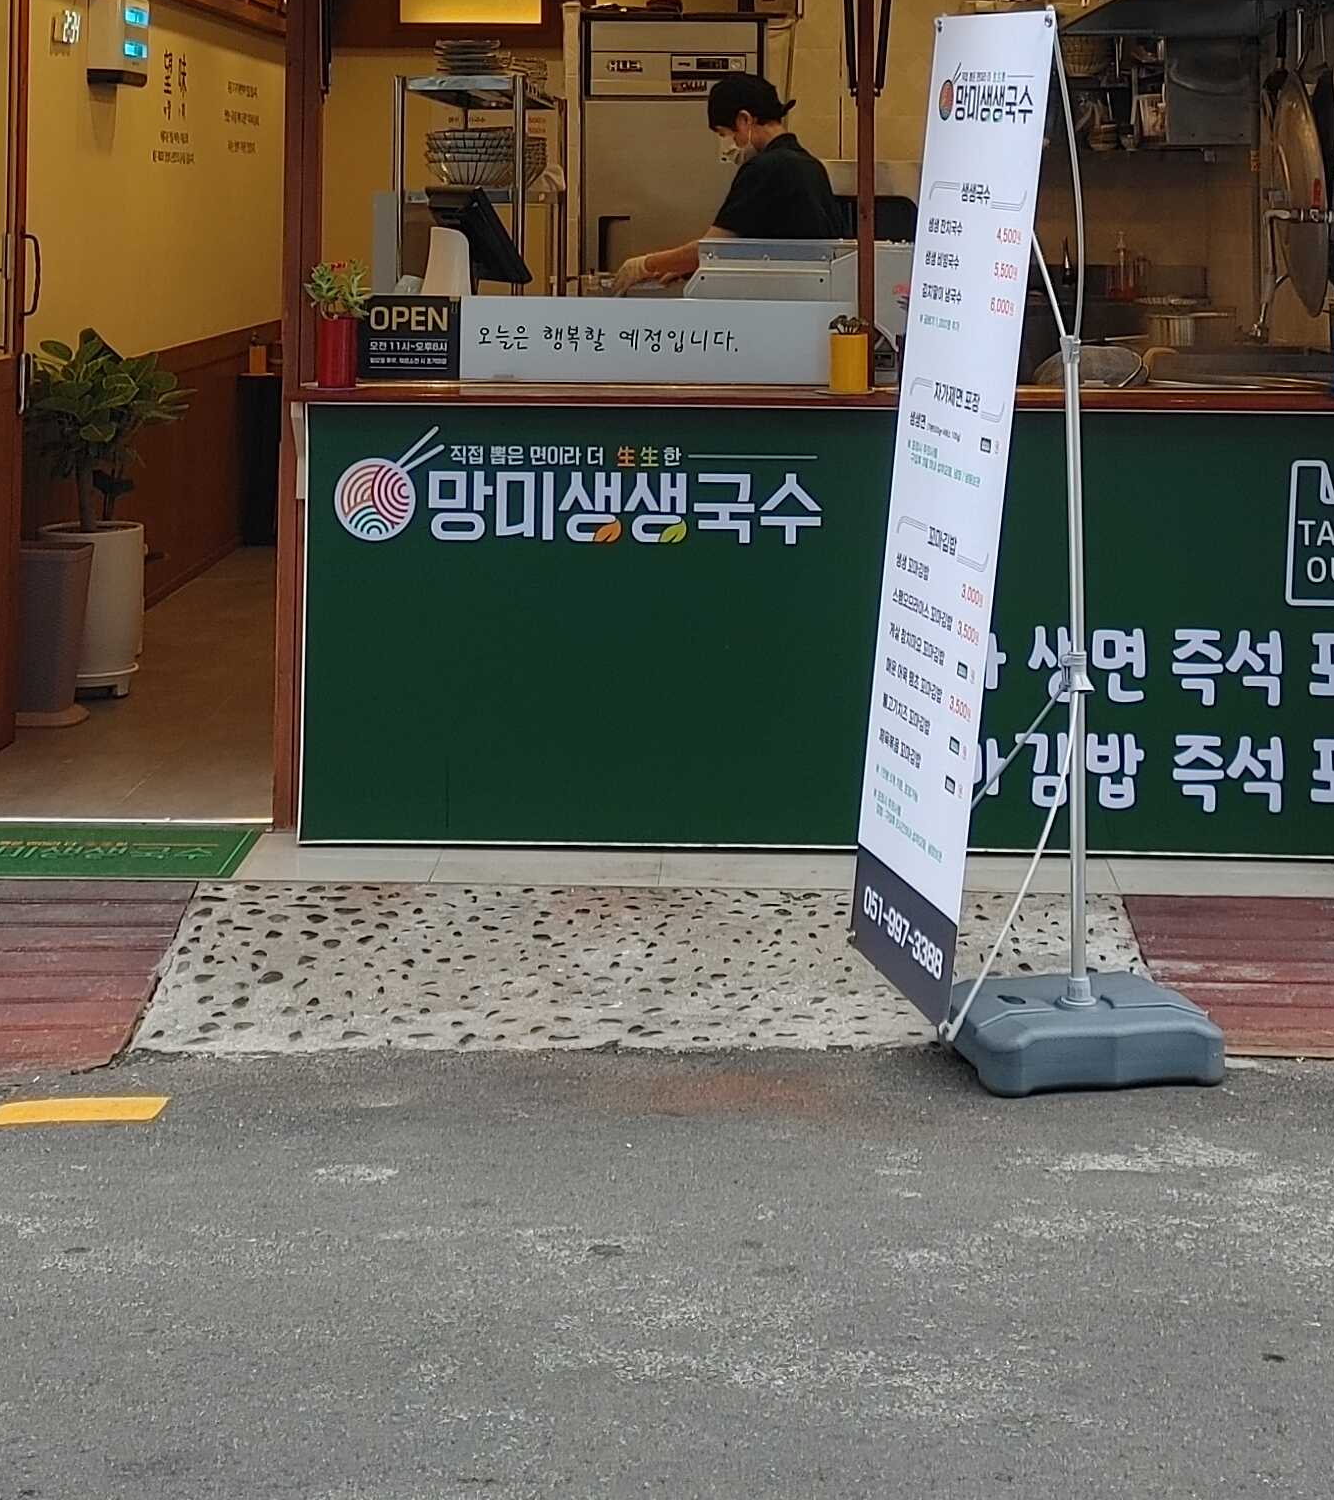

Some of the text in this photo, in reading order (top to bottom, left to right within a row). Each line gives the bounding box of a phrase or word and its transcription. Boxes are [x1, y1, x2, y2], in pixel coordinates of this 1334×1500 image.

[955, 85, 1034, 125] 망미생생국수
[961, 182, 991, 205] 생생국수
[370, 306, 448, 331] OPEN
[369, 341, 387, 351] 오전
[478, 325, 739, 353] 오늘은 행복할 예정입니다.
[934, 382, 981, 414] 자가제면 포장
[450, 446, 484, 465] 직접
[490, 446, 524, 465] 뽑은
[530, 446, 582, 466] 면이라
[587, 446, 604, 466] 더
[428, 470, 823, 545] 망미생생국수
[927, 526, 957, 556] 꼬마김밥
[907, 557, 930, 581] 꼬마김밥
[930, 606, 953, 631] 꼬마김밥
[922, 640, 945, 666] 꼬마김밥
[1171, 629, 1283, 706] 즉석
[920, 677, 943, 704] 꼬마김밥
[908, 709, 931, 736] 꼬마김밥
[899, 741, 922, 769] 꼬마김밥
[1171, 735, 1284, 812] 즉석
[863, 886, 944, 980] 051-997-3388
